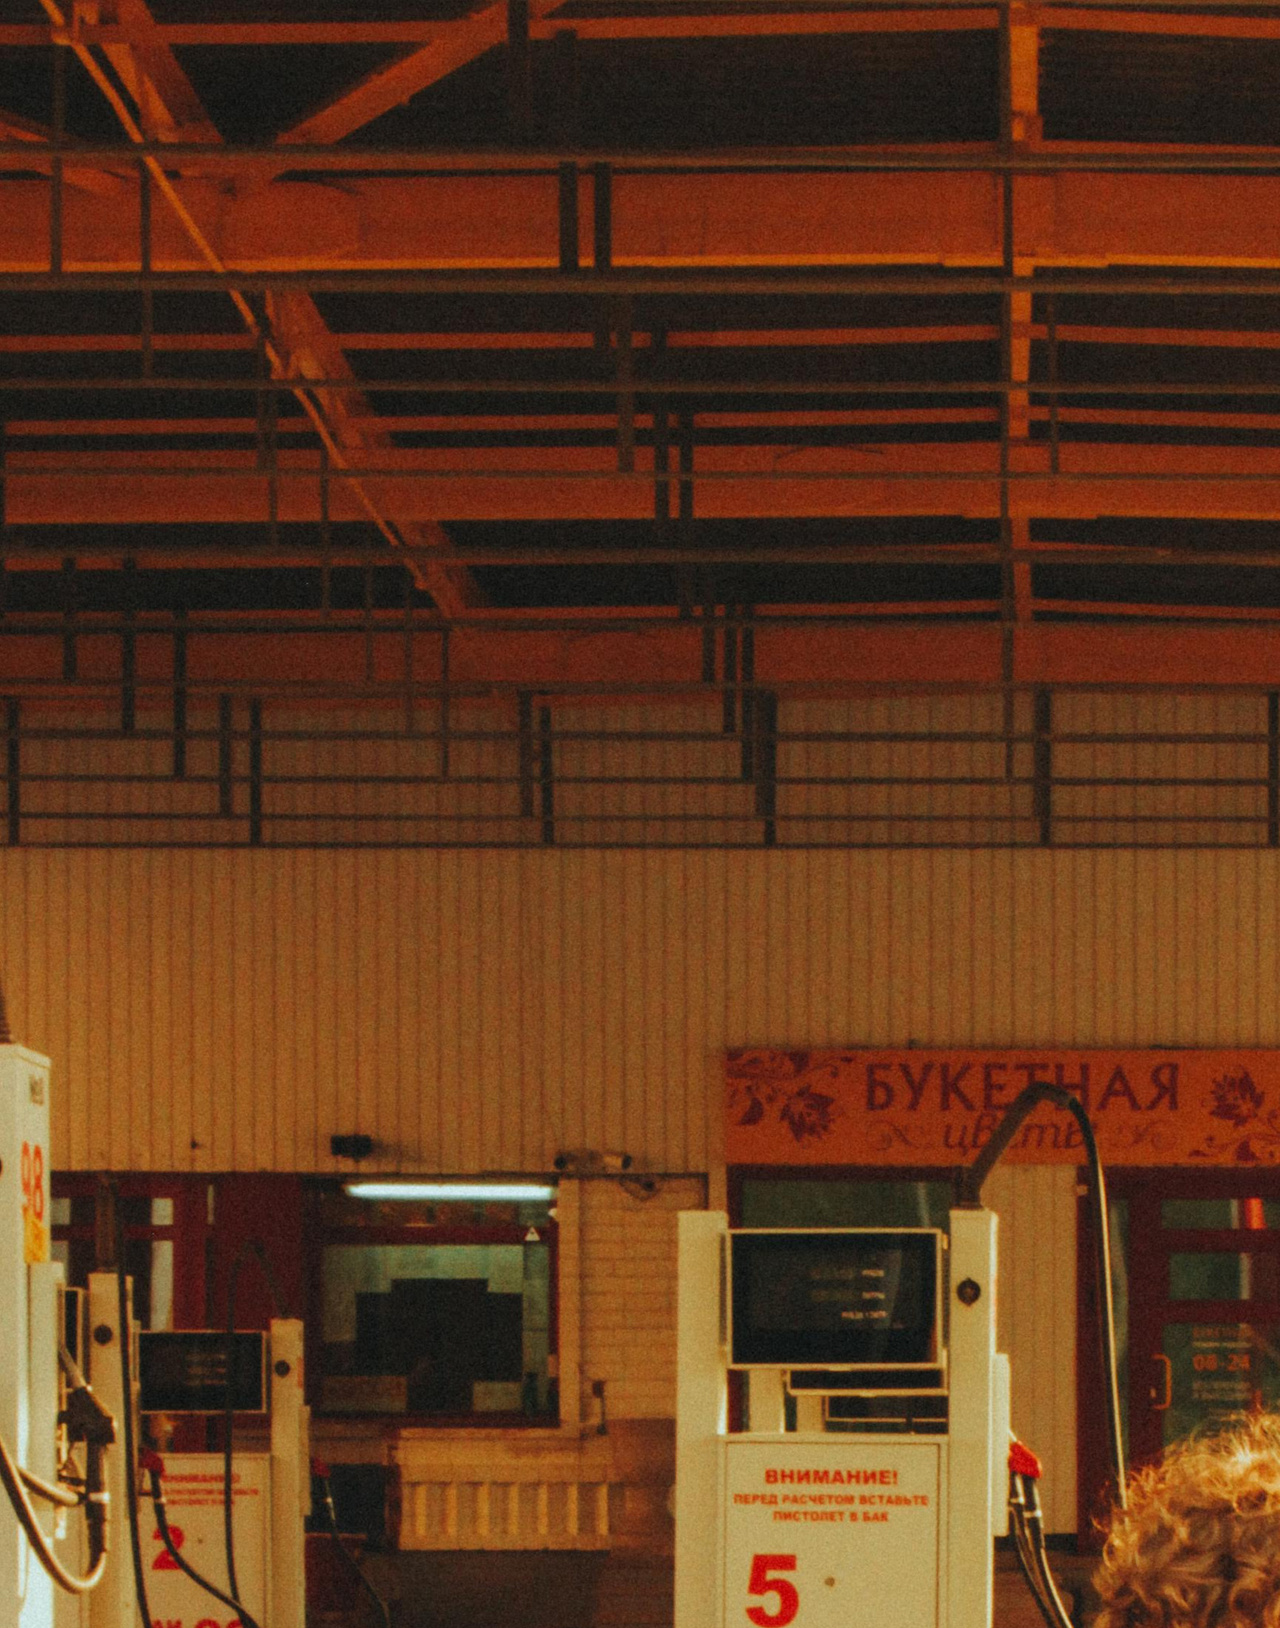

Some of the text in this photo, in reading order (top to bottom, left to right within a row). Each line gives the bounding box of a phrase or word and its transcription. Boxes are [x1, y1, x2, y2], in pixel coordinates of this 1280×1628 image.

[866, 1063, 1179, 1112] БУКЕТНАЯ
[764, 1468, 898, 1485] ВНИМАНИЕ!
[733, 1494, 929, 1507] ПЕРЕД РАСЧЕТОМ ВСТАВЬТЕ
[773, 1511, 888, 1522] ПИСТОЛЕТ В БАК
[152, 1525, 185, 1570] 2
[745, 1553, 799, 1628] 5
